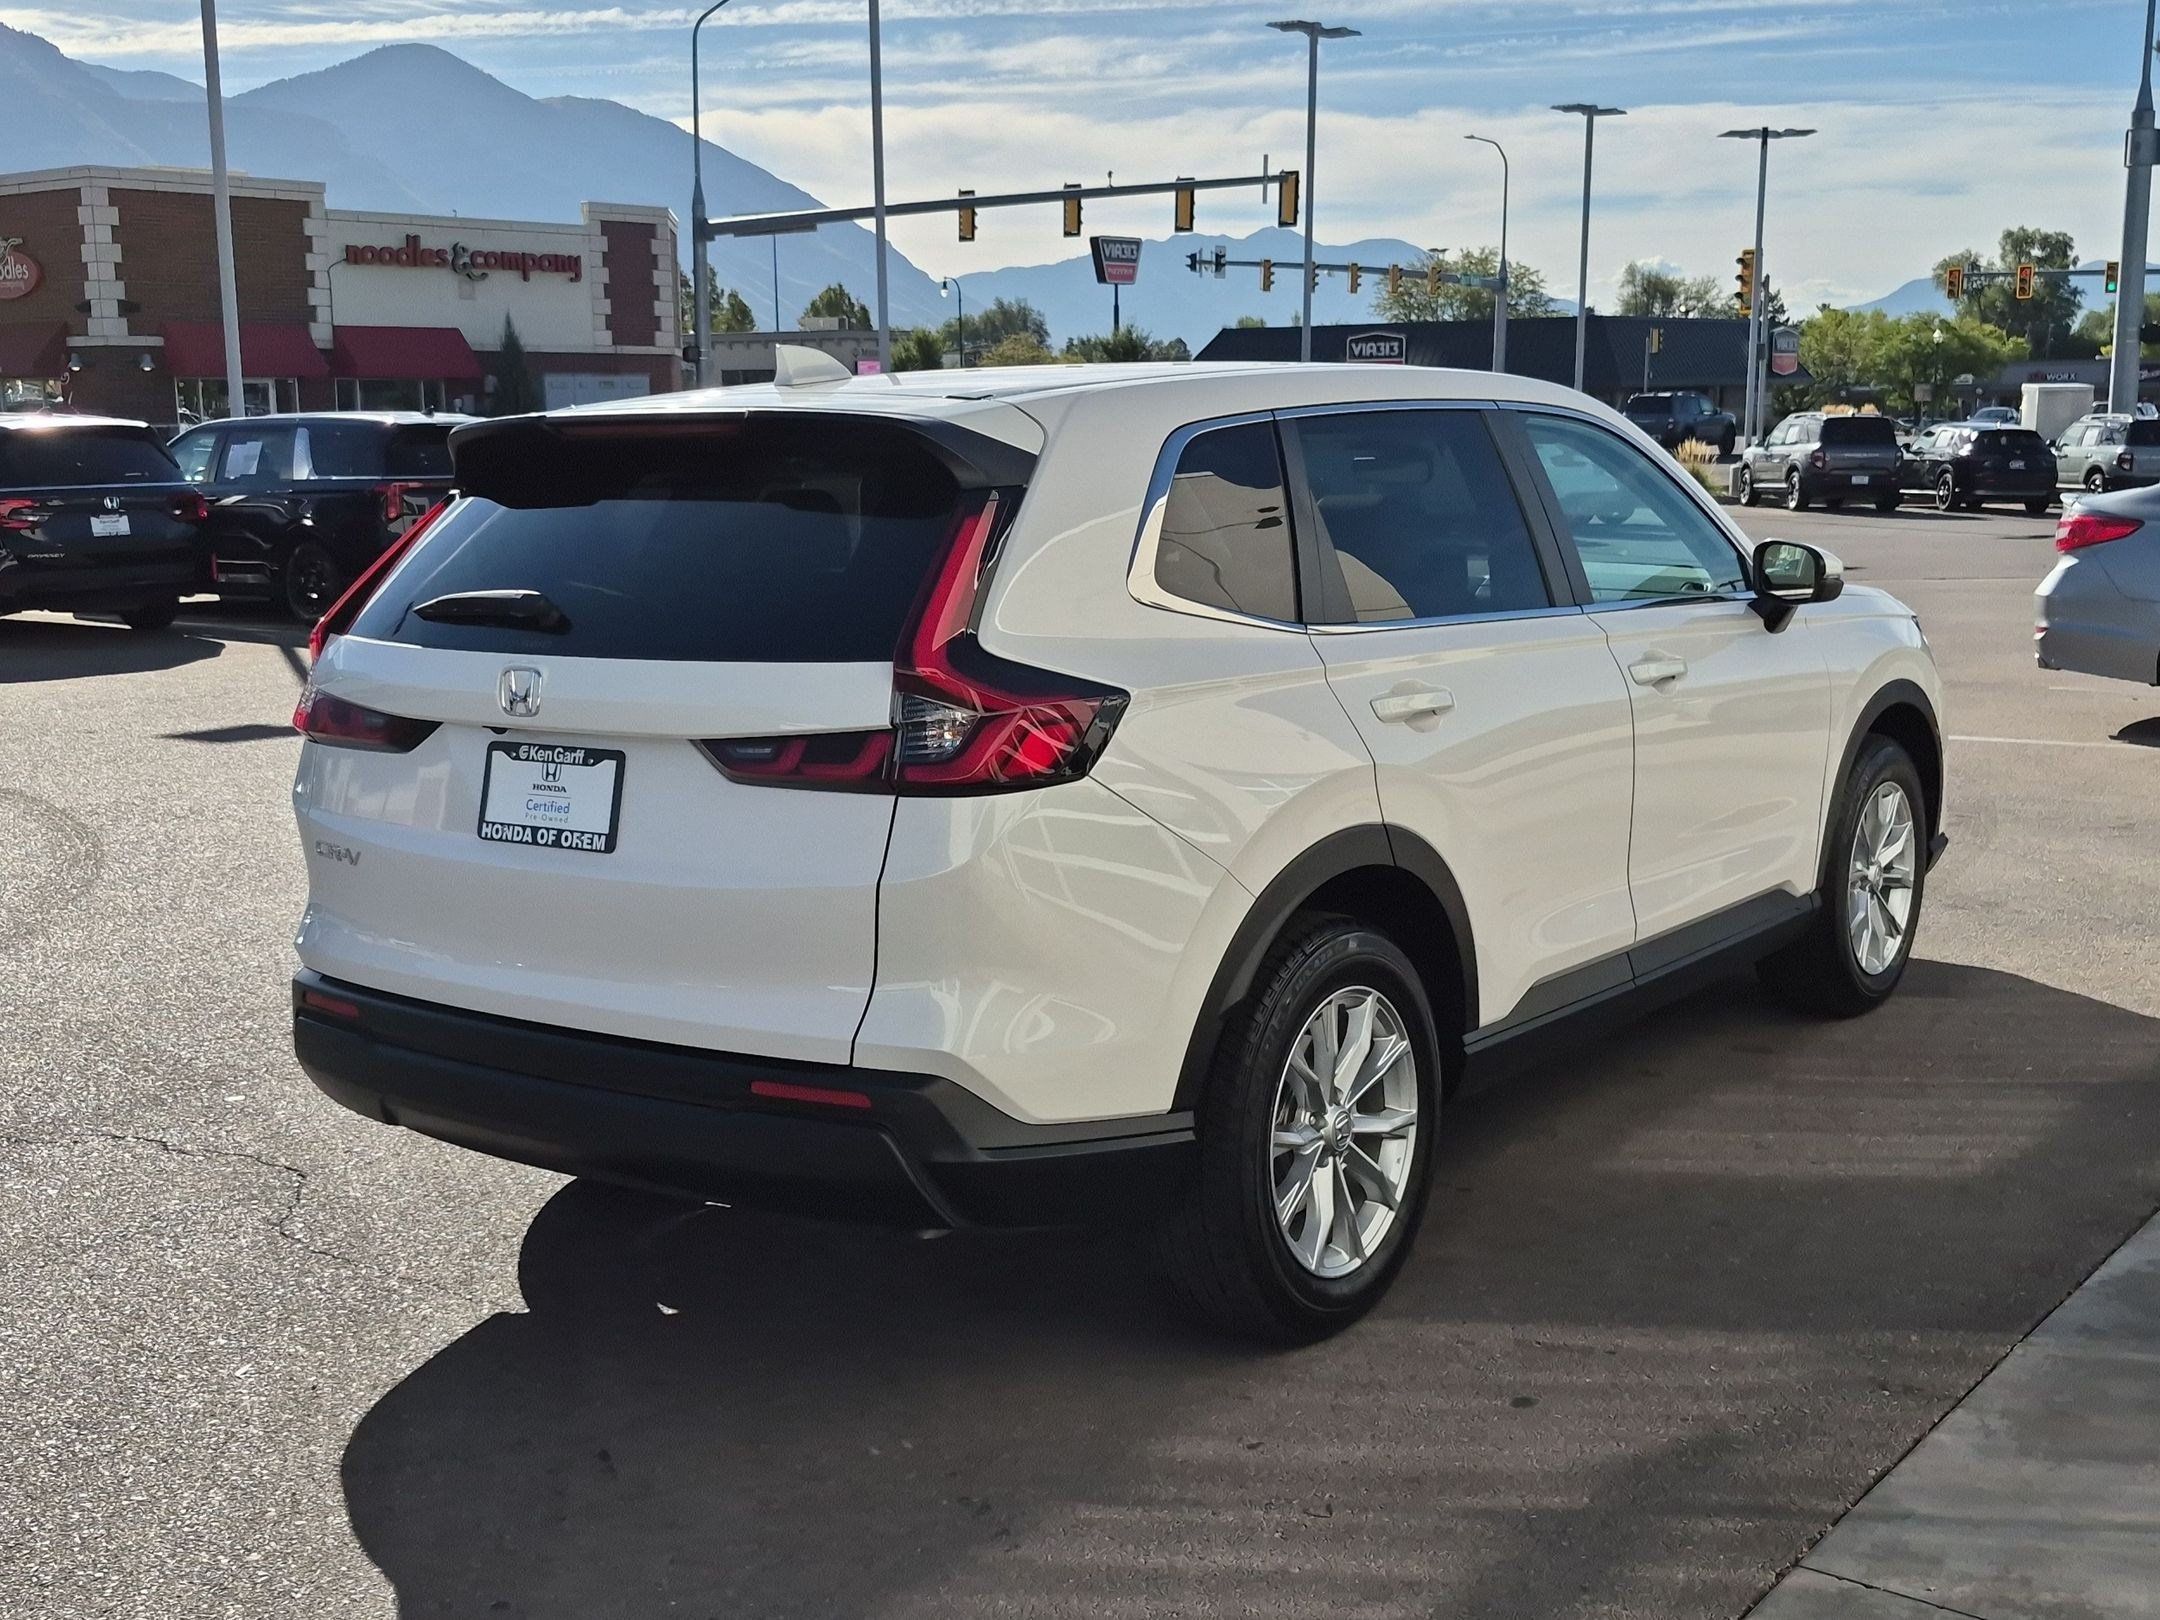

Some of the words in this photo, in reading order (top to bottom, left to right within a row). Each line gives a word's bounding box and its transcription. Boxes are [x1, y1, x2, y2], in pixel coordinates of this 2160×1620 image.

[345, 233, 449, 267] noodles
[471, 250, 582, 283] company
[532, 783, 567, 793] HONDA
[526, 799, 571, 814] Certified
[481, 822, 533, 843] HONDA
[536, 828, 558, 845] OF
[561, 831, 607, 851] OREM
[315, 840, 361, 866] CR-V
